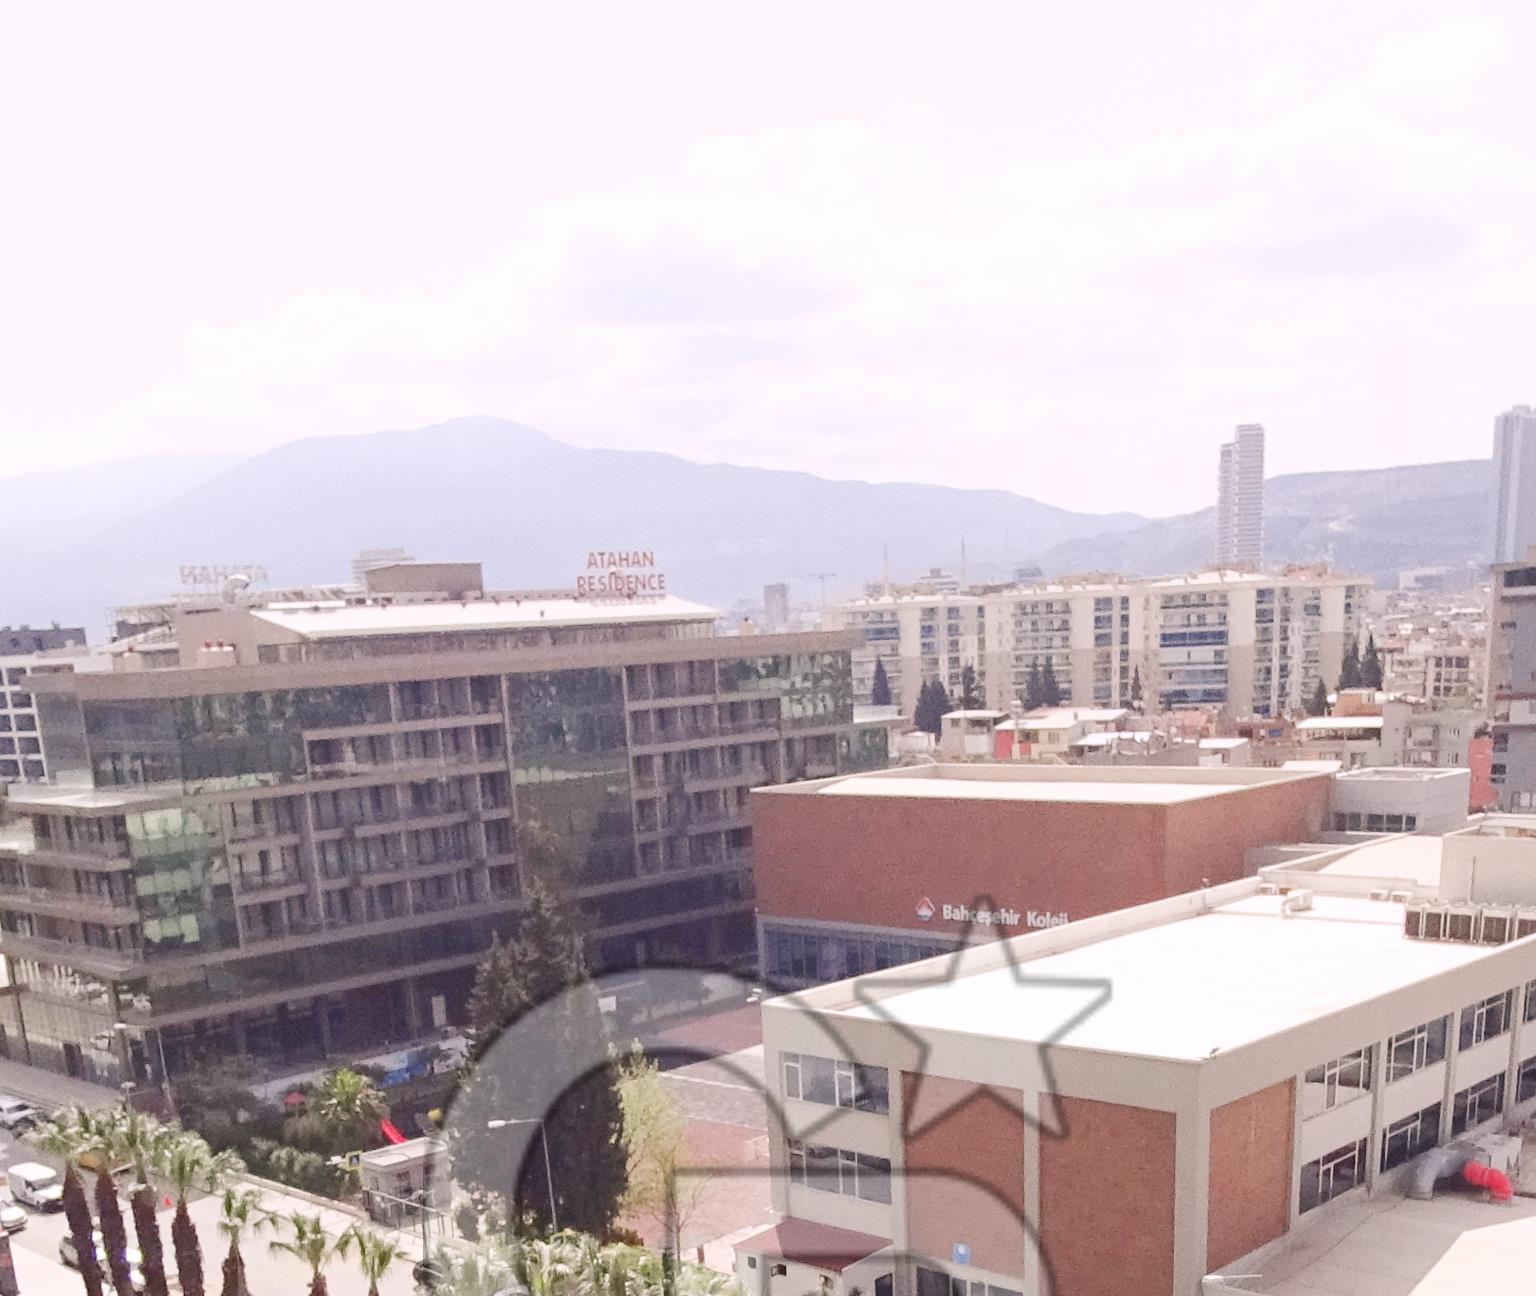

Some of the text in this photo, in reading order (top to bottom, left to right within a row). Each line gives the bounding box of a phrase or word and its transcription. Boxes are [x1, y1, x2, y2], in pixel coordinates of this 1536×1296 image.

[587, 551, 654, 569] ATAHAN
[576, 573, 666, 593] RESIDENCE
[942, 903, 1021, 927] Bahçeşehir
